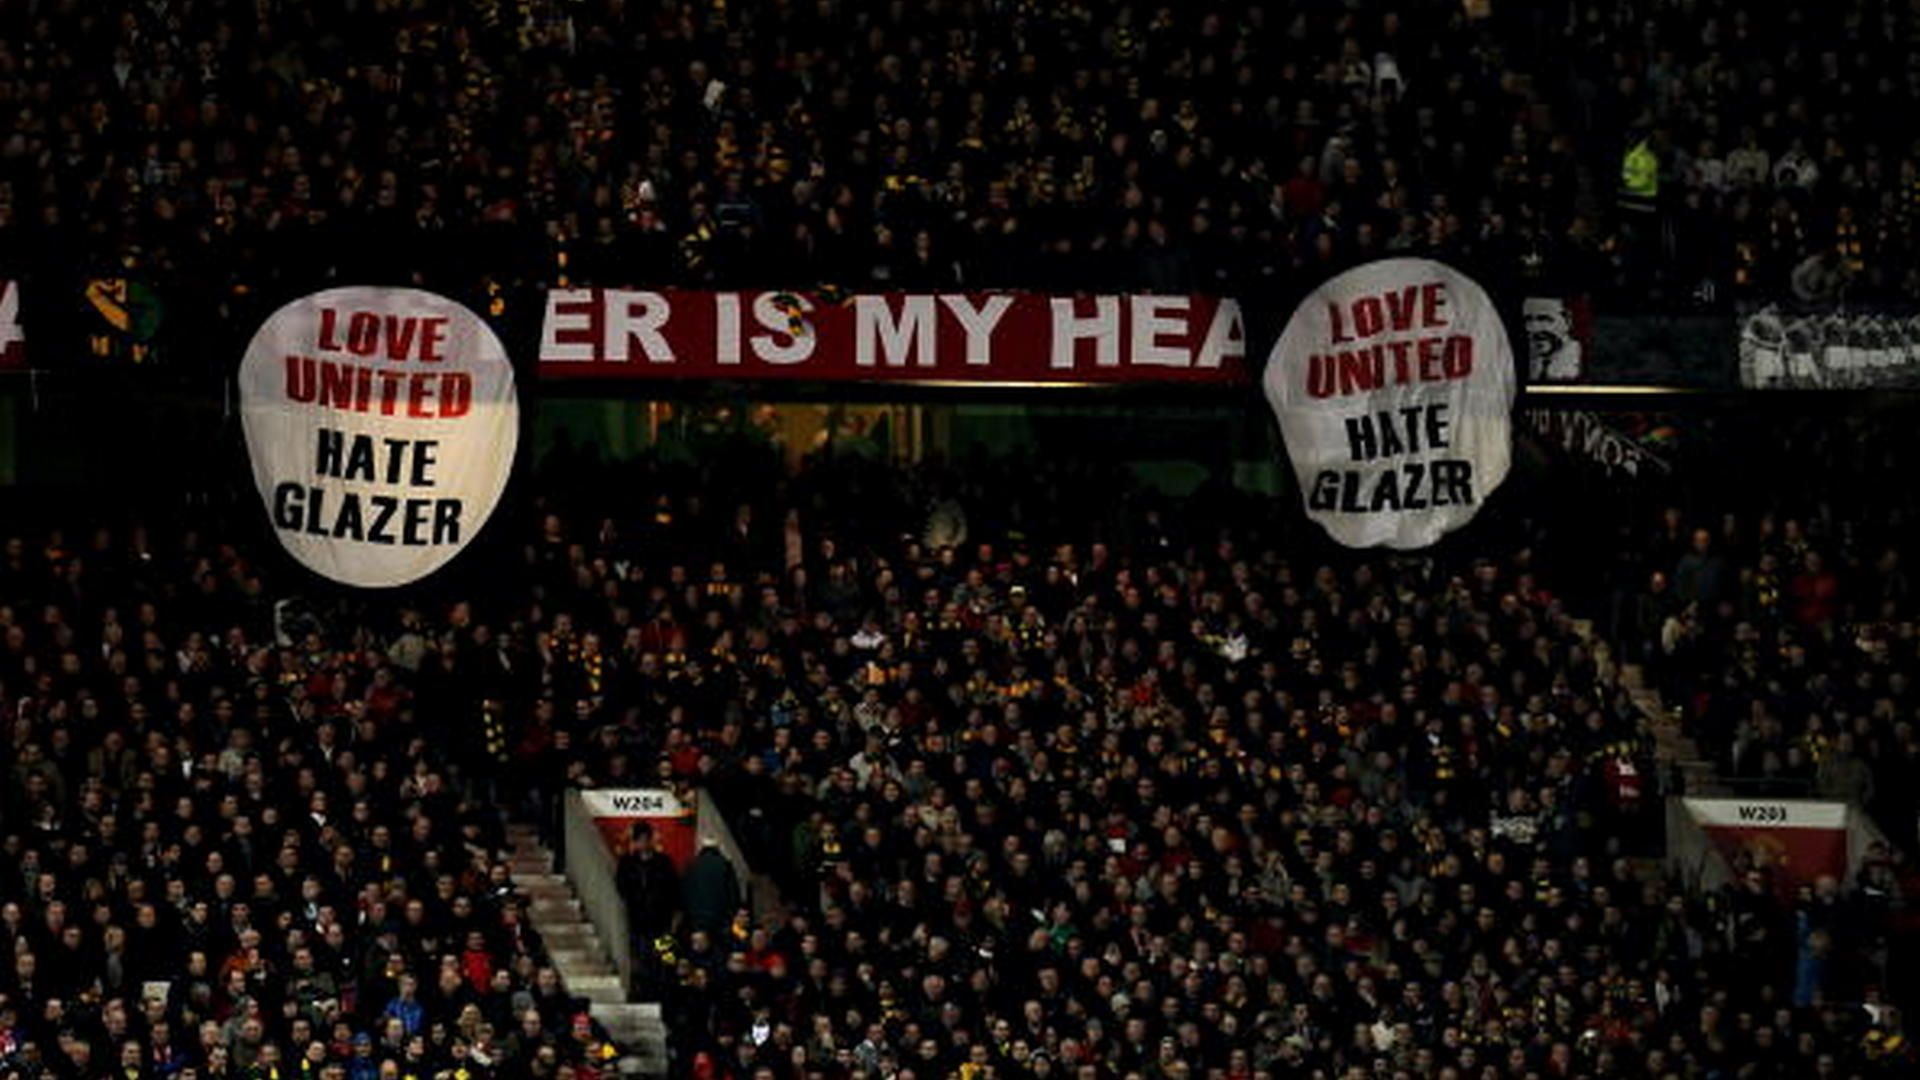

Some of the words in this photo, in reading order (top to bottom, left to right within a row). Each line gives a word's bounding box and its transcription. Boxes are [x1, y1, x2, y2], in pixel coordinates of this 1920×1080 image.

[318, 308, 448, 362] LOVE
[715, 290, 817, 366] IS
[855, 293, 1017, 367] MY
[1329, 283, 1449, 343] LOVE
[285, 356, 472, 418] UNITED
[1307, 335, 1473, 398] UNITED
[316, 428, 439, 486] HATE
[1346, 404, 1450, 460] HATE
[274, 483, 463, 545] GLAZER
[1309, 461, 1474, 512] GLAZER
[612, 796, 664, 811] W204
